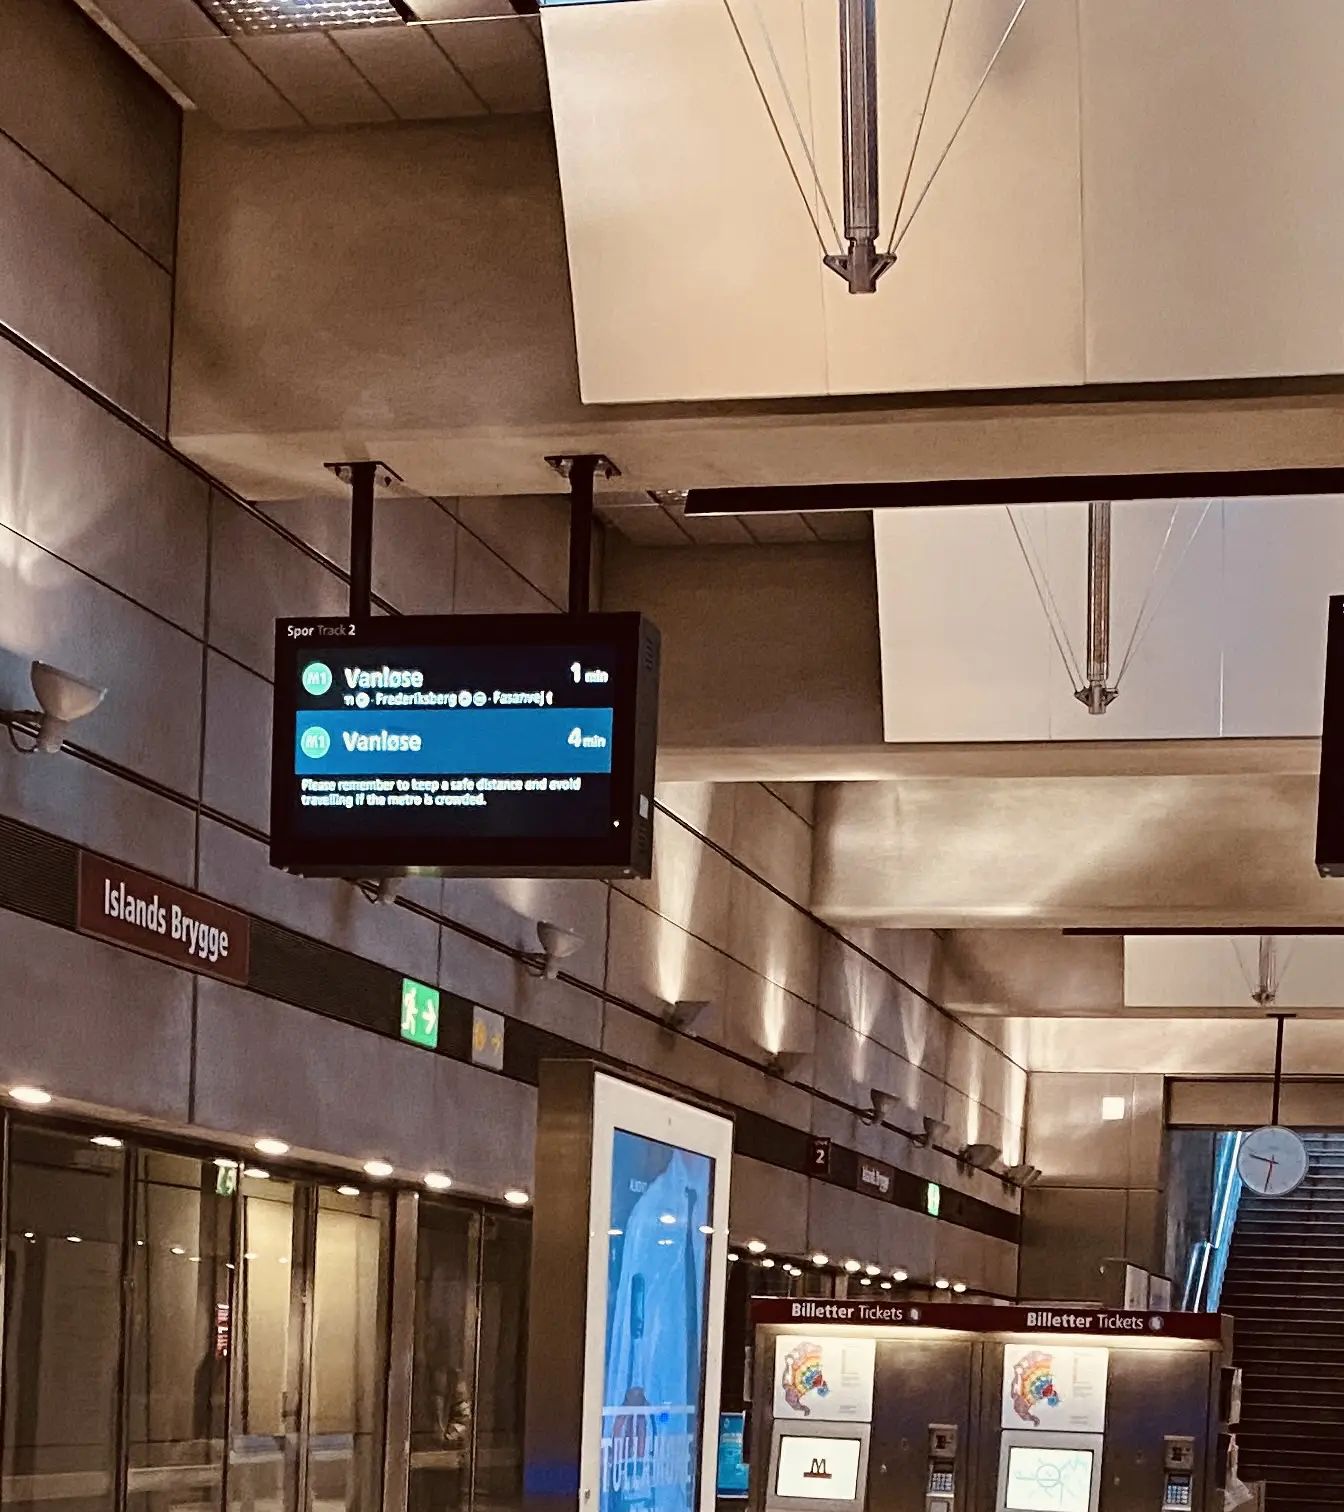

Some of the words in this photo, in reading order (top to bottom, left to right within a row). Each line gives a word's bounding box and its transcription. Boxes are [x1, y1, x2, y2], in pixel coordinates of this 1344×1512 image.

[287, 625, 314, 639] Spor
[317, 624, 346, 636] Track
[348, 624, 356, 636] 2
[570, 662, 581, 684] 1
[584, 670, 609, 683] min
[376, 692, 456, 707] Frederiksberg
[568, 727, 581, 748] 4
[582, 735, 606, 748] min
[104, 878, 166, 935] Islands
[171, 904, 229, 963] Brygge
[816, 1149, 825, 1164] 2
[791, 1302, 854, 1319] Billetter
[858, 1305, 903, 1320] Tickets
[1027, 1312, 1092, 1328] Billetter
[1097, 1314, 1144, 1330] Tickets
